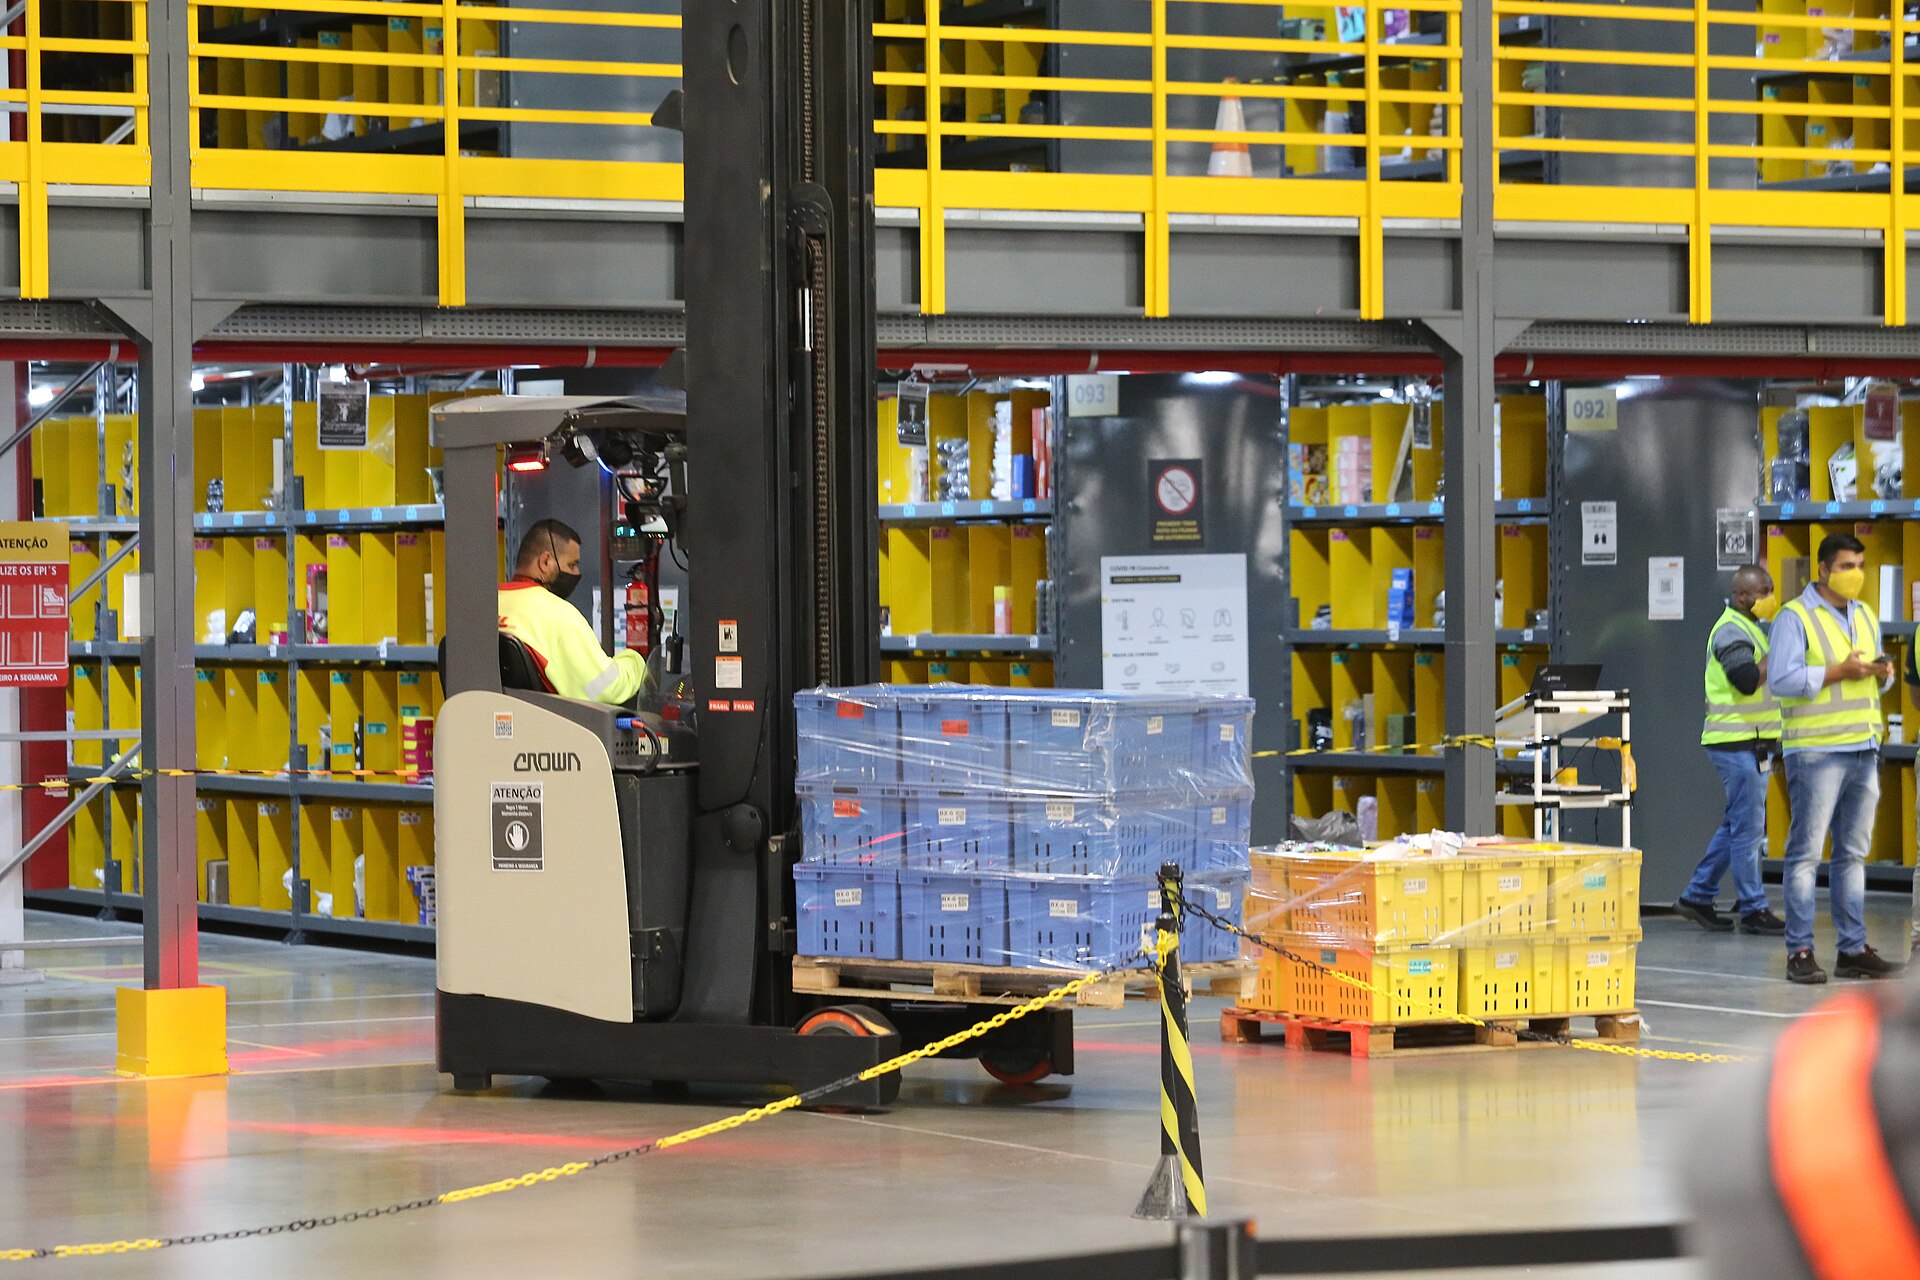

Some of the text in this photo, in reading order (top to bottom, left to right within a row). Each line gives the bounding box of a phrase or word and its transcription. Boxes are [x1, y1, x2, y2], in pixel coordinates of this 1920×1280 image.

[1075, 384, 1105, 403] 093
[1573, 399, 1605, 418] 092
[20, 566, 32, 576] OS
[14, 673, 19, 681] A
[20, 673, 58, 682] SEGURANÇA
[514, 752, 581, 771] CROWN
[494, 785, 541, 800] ATENÇÃO
